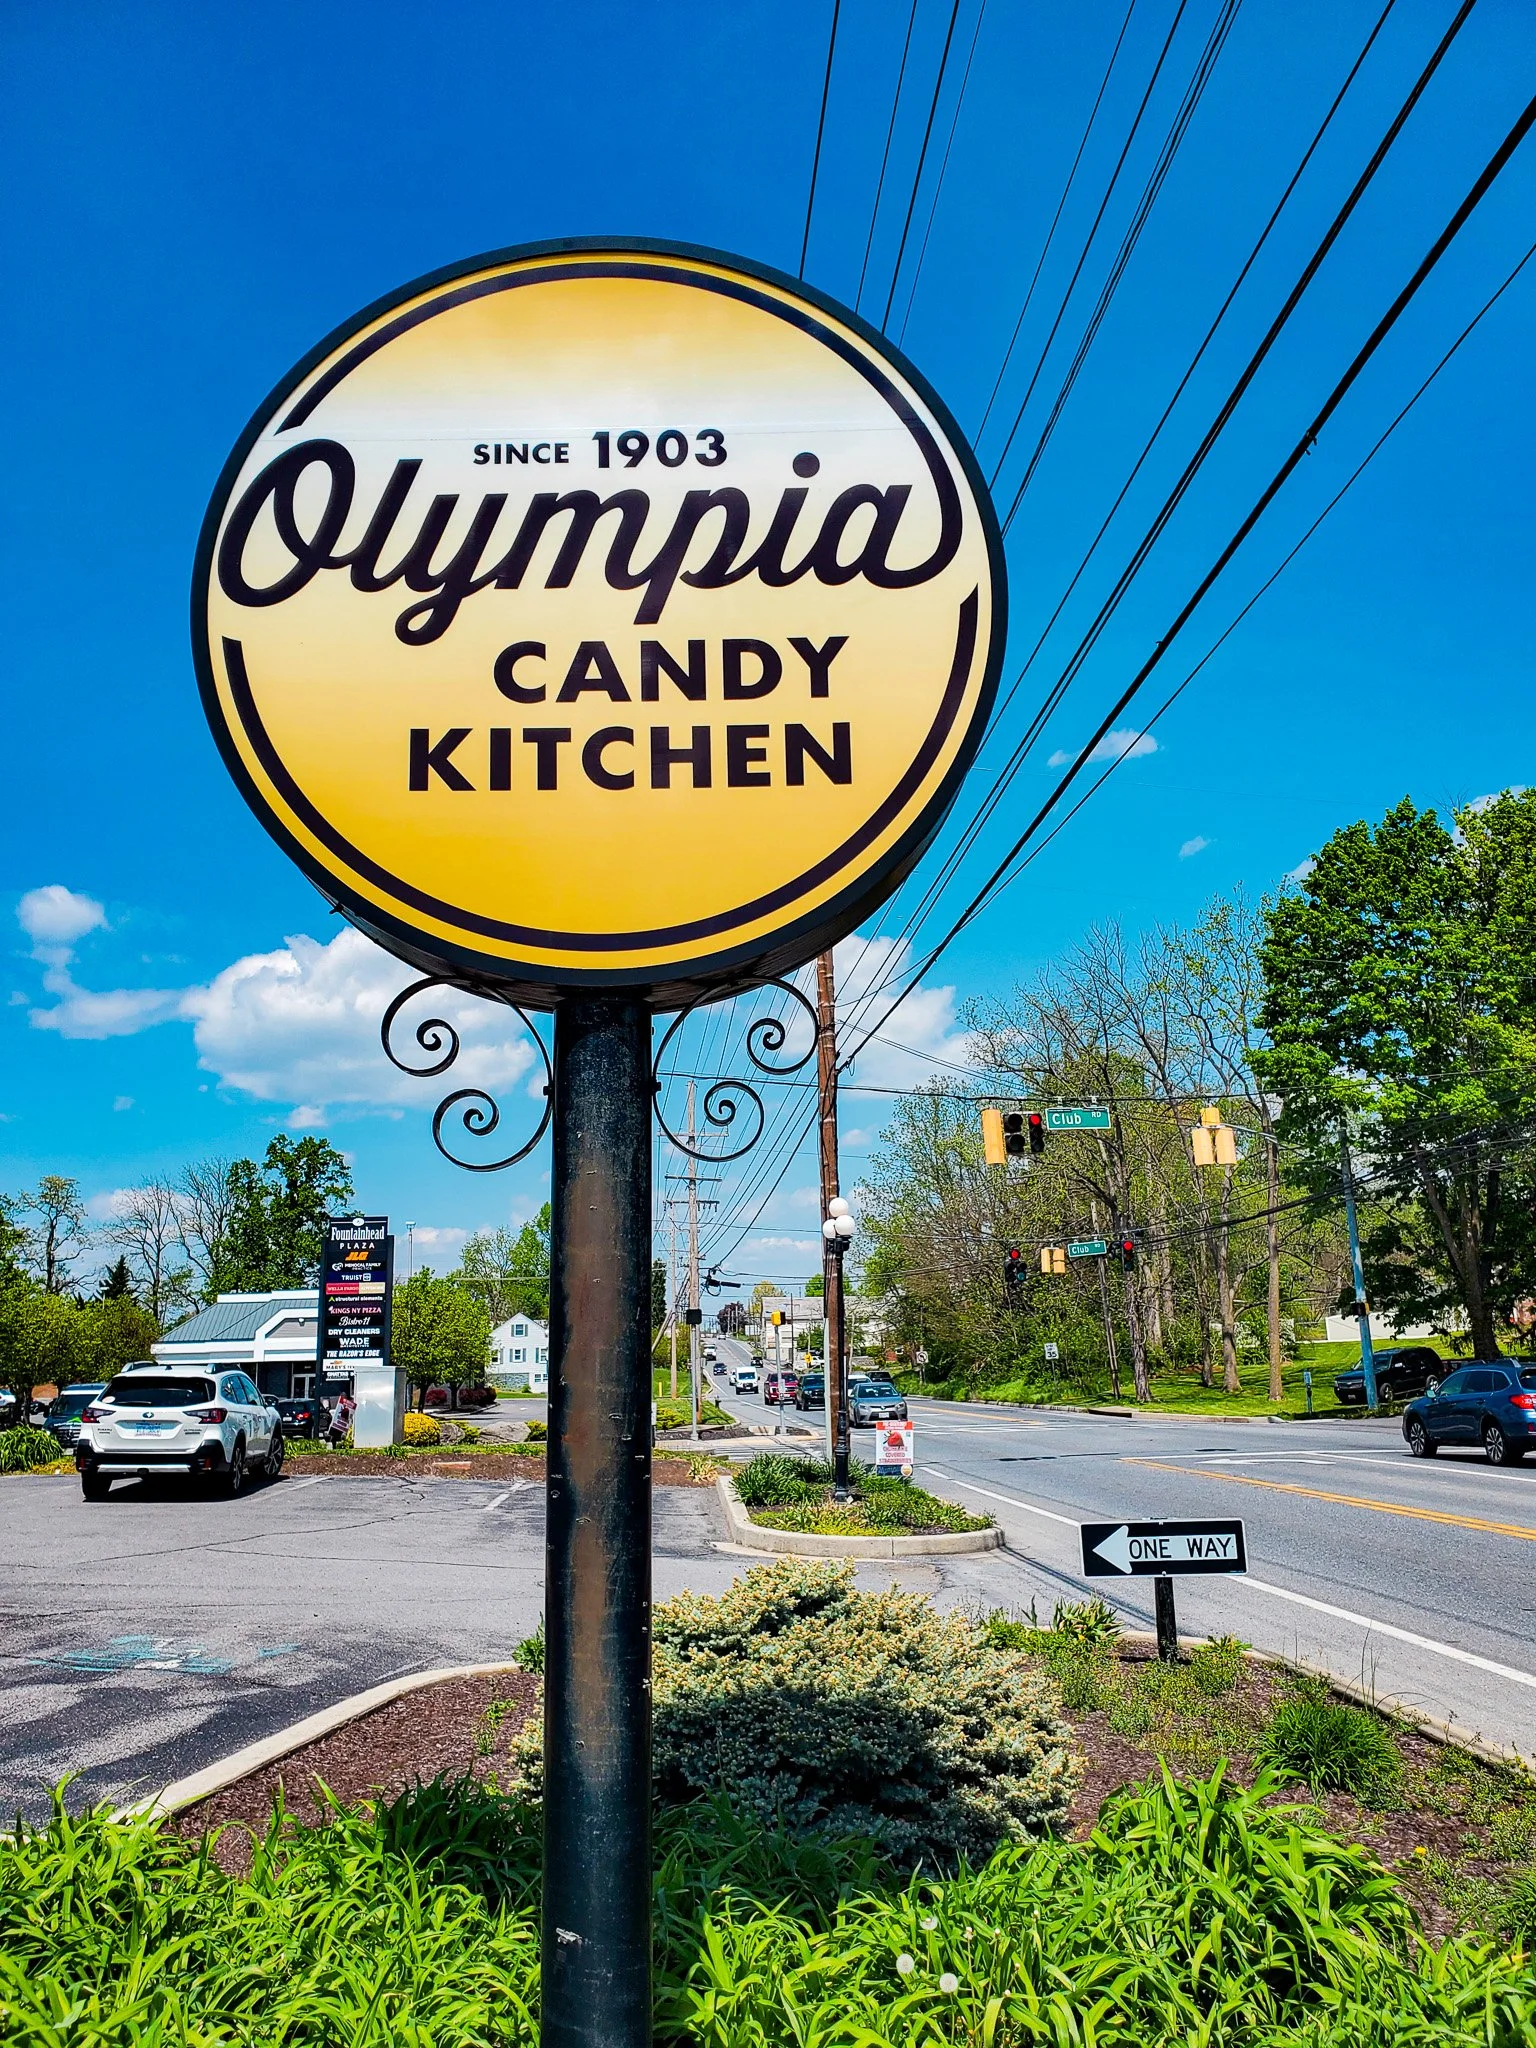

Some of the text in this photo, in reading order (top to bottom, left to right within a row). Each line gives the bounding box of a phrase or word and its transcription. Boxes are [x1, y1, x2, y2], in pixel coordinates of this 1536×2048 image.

[473, 429, 728, 469] SINCE 1903
[217, 437, 945, 646] Olympia
[492, 636, 850, 704] CANDY
[408, 721, 853, 792] KITCHEN
[1052, 1112, 1082, 1125] Club
[331, 1226, 385, 1241] Fountainhead
[340, 1242, 375, 1250] PLAZA
[1071, 1245, 1090, 1254] Club
[344, 1251, 369, 1261] JLG
[339, 1337, 370, 1345] WADE
[326, 1349, 380, 1358] THE RAZOR'S EDGE
[1128, 1537, 1232, 1560] ONE WAY
